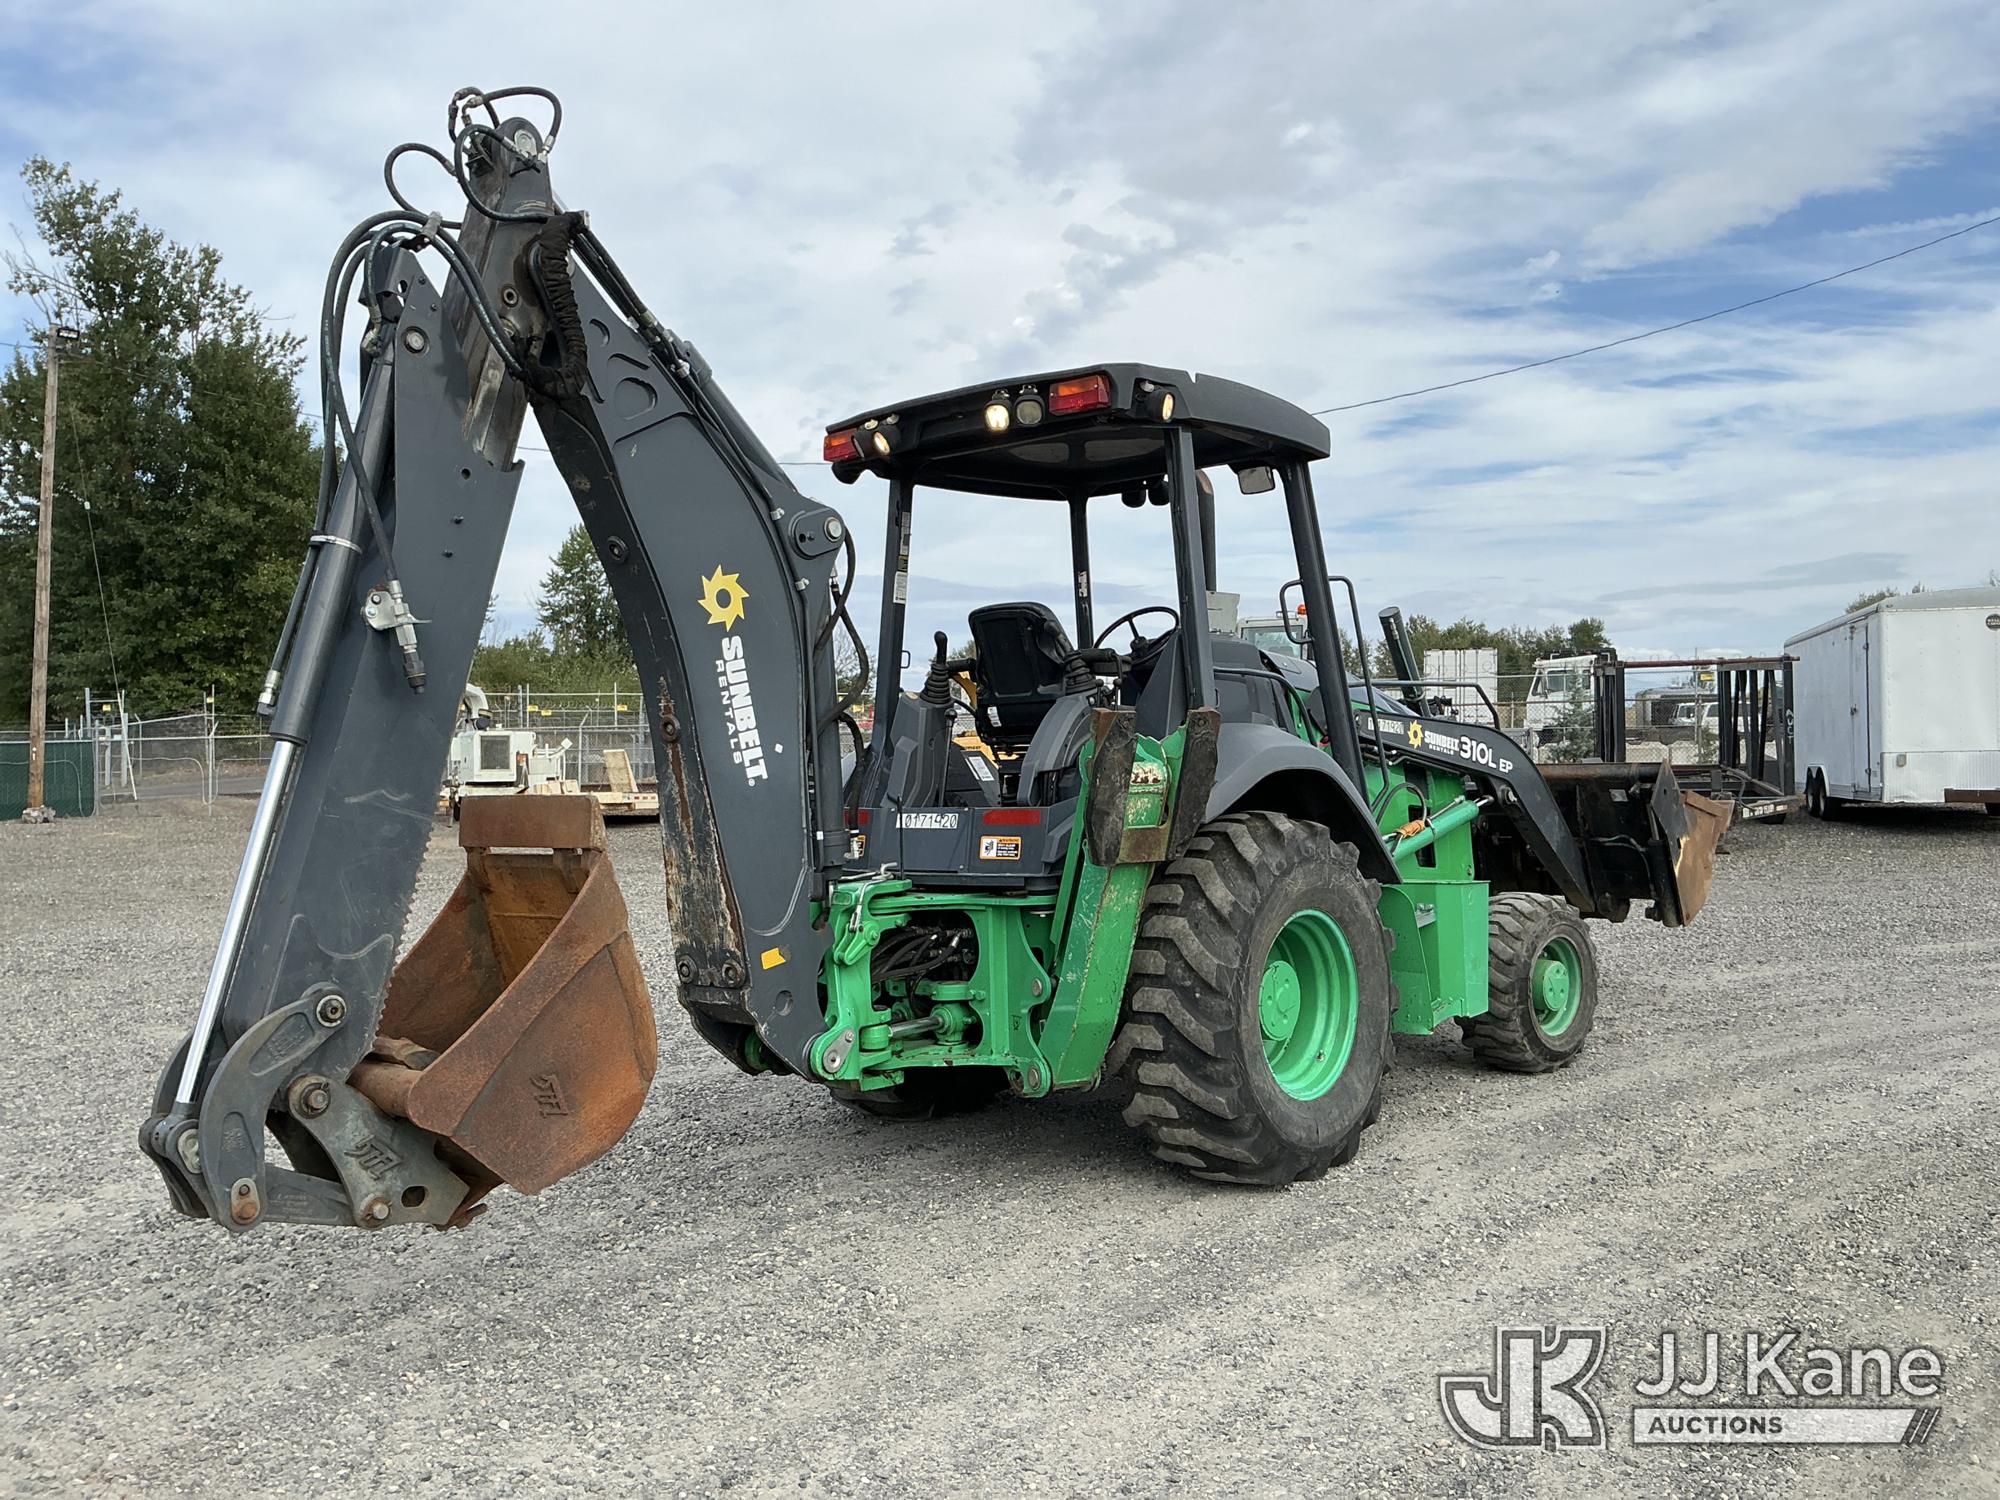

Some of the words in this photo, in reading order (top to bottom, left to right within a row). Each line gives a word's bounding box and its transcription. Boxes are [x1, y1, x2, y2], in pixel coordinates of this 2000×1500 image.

[715, 659, 742, 764] RENTALS
[721, 635, 768, 779] SUNBELT
[1424, 730, 1460, 752] SUNBELT
[1428, 744, 1455, 755] RENTALS
[1460, 736, 1496, 769] 310L
[1499, 758, 1513, 773] EP
